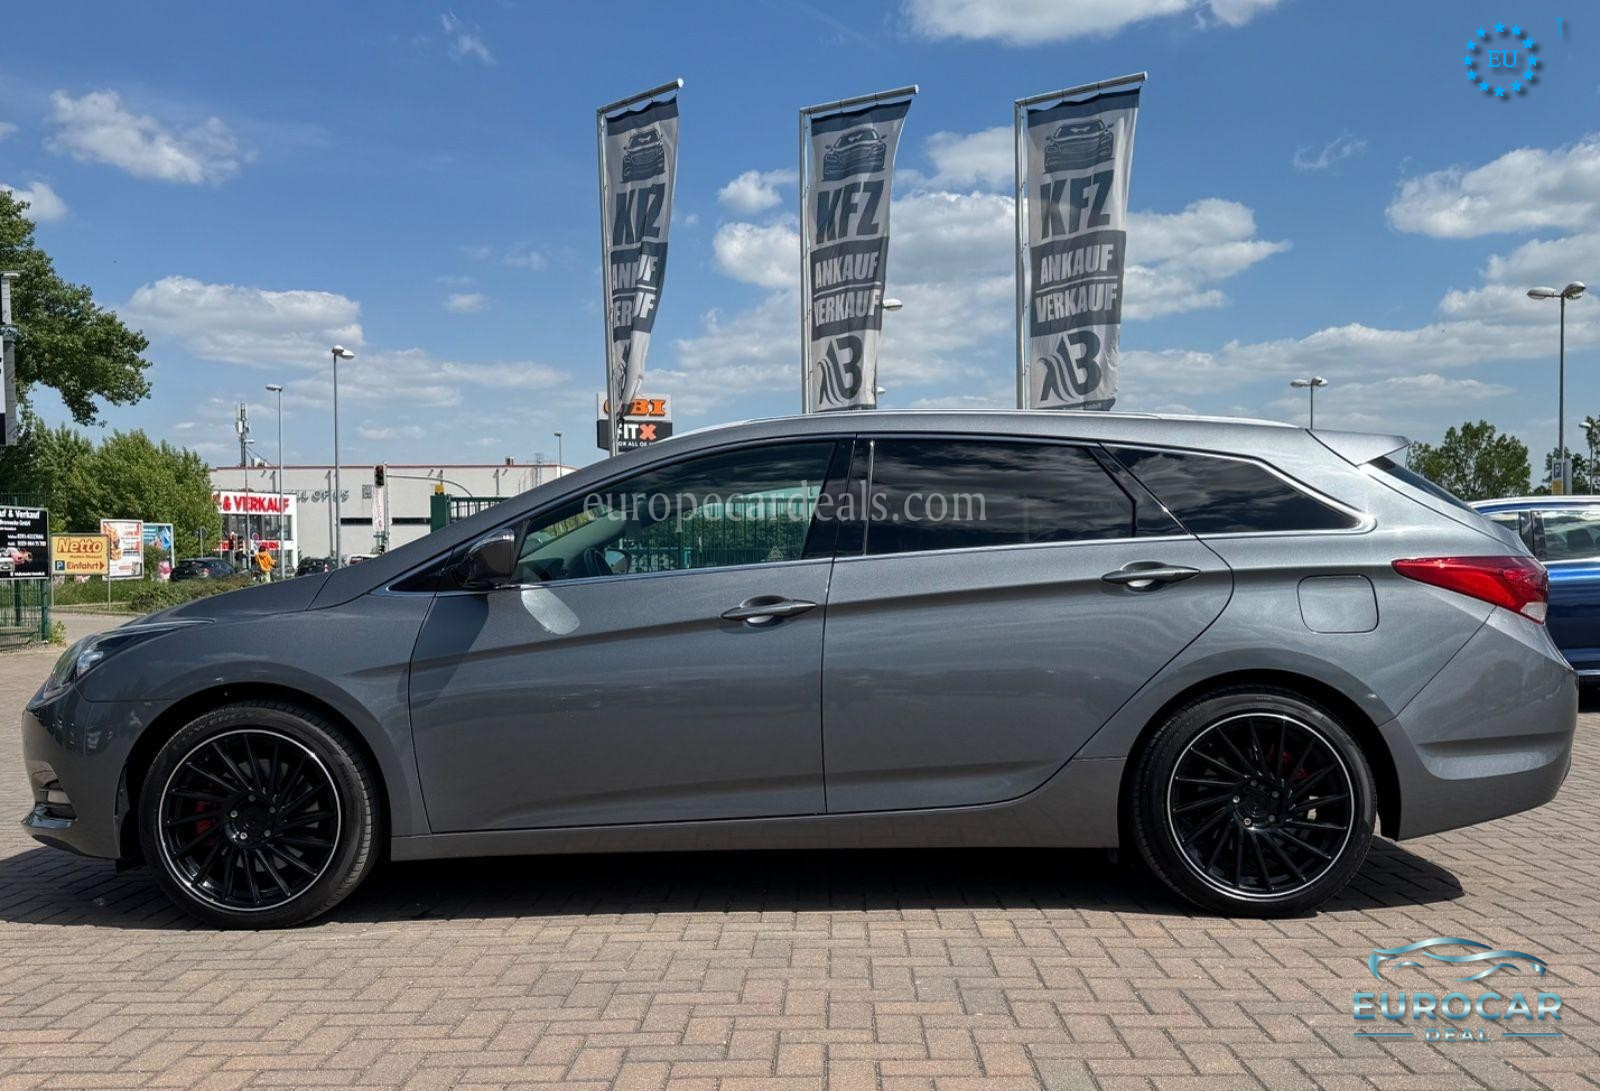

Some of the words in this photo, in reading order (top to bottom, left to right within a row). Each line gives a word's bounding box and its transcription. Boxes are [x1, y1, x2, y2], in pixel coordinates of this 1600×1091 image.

[816, 180, 884, 244] KFZ
[1040, 169, 1114, 240] KFZ
[815, 252, 879, 288] ANKAUF
[1040, 244, 1114, 285] ANKAUF
[813, 289, 881, 327] VERKAUF
[1035, 283, 1118, 323] VERKAUF
[223, 495, 231, 511] &
[233, 496, 289, 512] VERKAUF
[57, 538, 103, 553] Netto
[56, 561, 64, 570] P
[67, 561, 99, 571] Einfahrt
